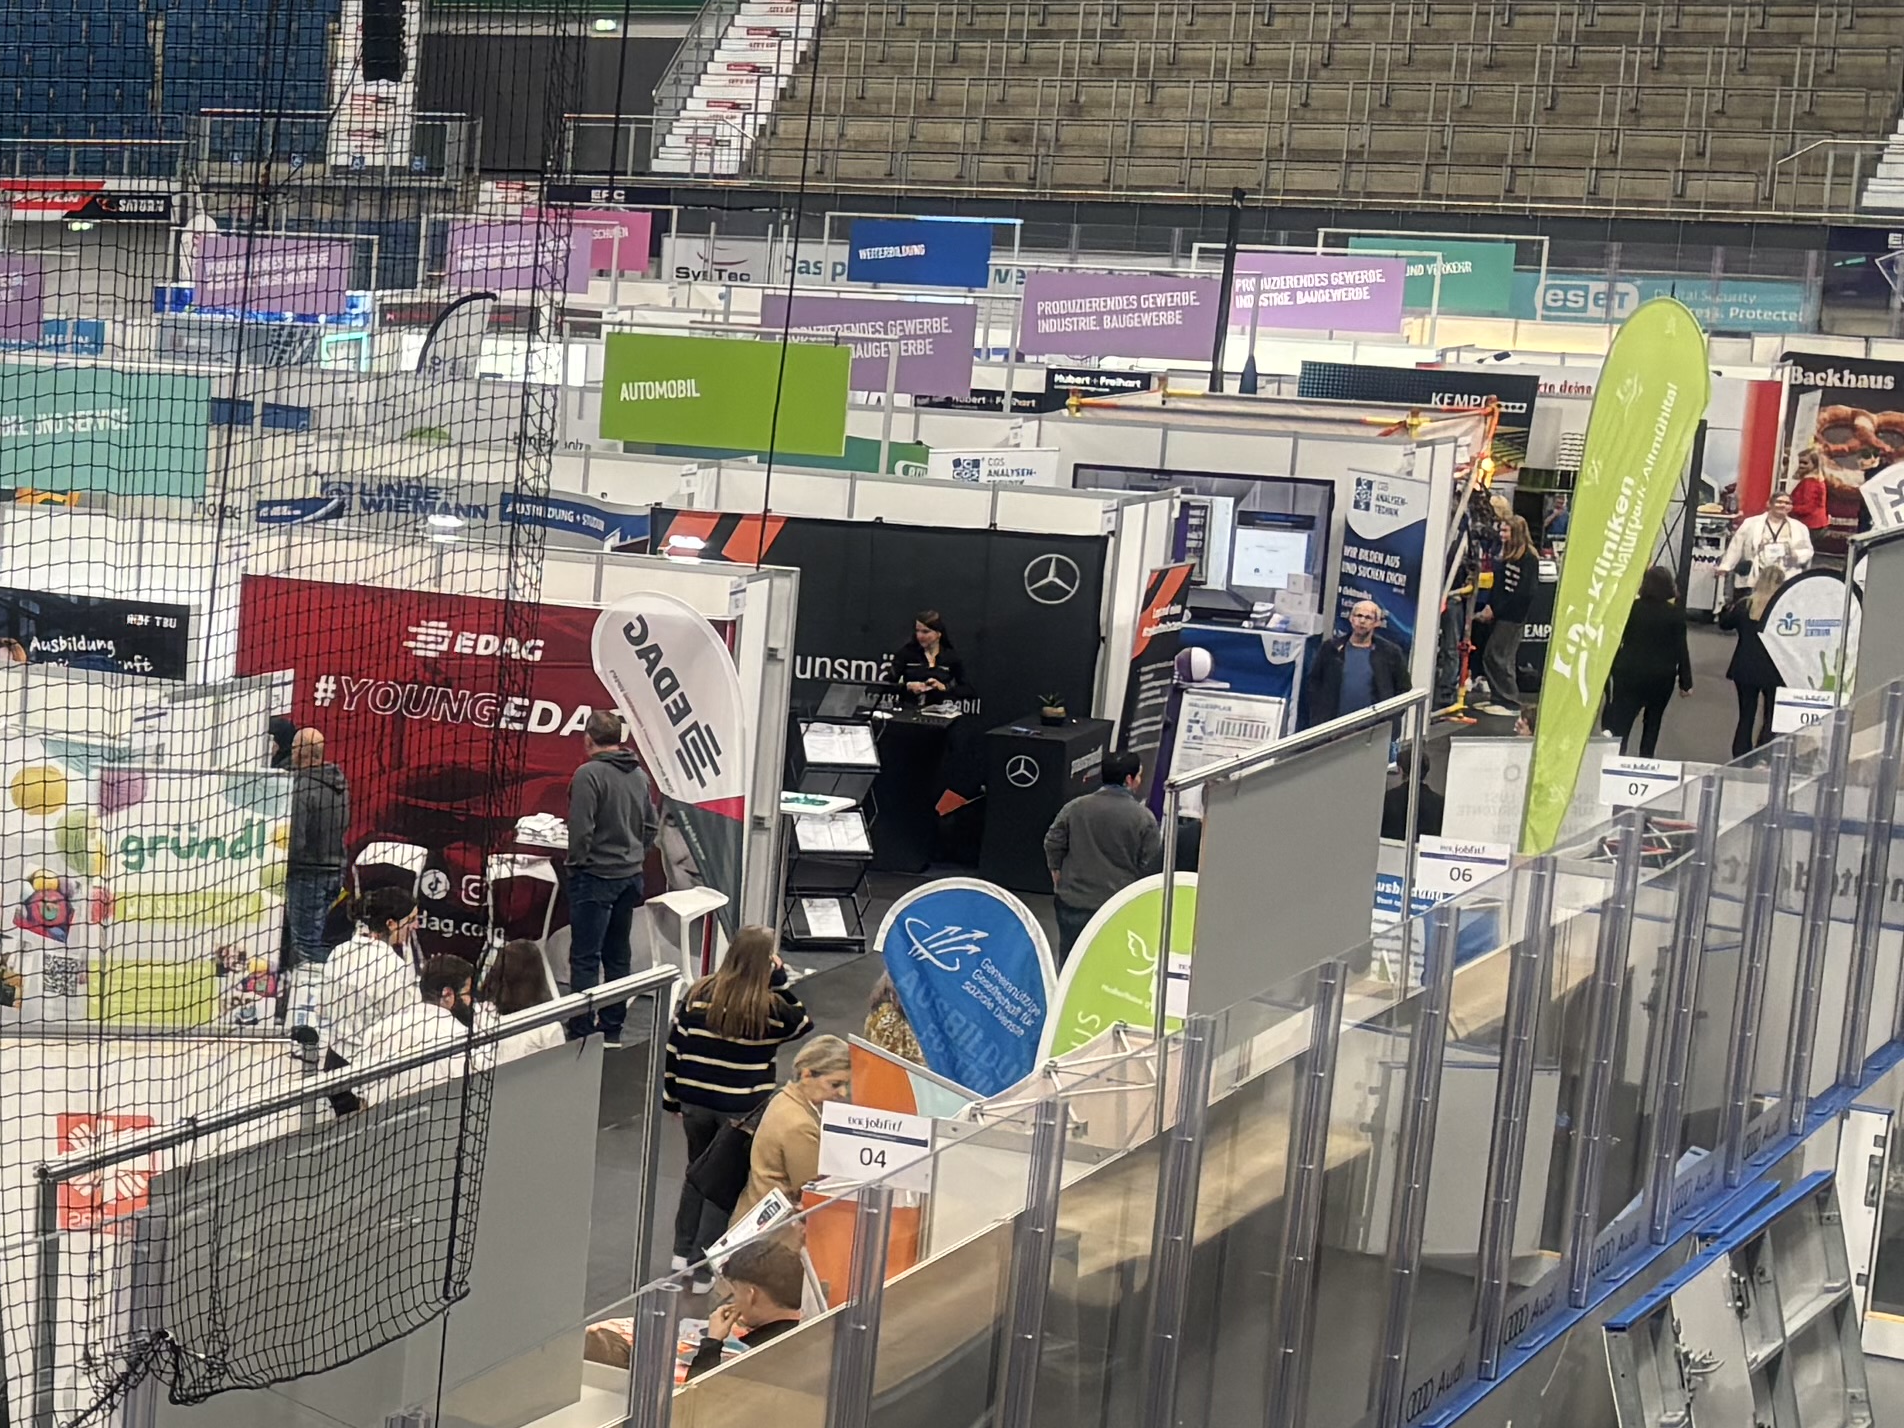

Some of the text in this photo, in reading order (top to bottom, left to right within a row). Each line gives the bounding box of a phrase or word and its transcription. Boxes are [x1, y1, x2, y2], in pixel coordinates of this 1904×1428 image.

[858, 245, 925, 260] WEITERBILDUNG
[1037, 295, 1137, 316] PRODUZIERENDES
[1103, 311, 1183, 329] BAUGEWERBE
[1790, 364, 1895, 391] Backhaus
[620, 377, 701, 403] AUTOMOBIL
[29, 635, 116, 654] Ausbildung
[454, 631, 544, 662] EDAG
[622, 613, 691, 729] EDAG
[1628, 781, 1649, 797] 07
[121, 817, 265, 870] gründl
[1449, 867, 1473, 882] 06
[860, 1147, 887, 1168] 04
